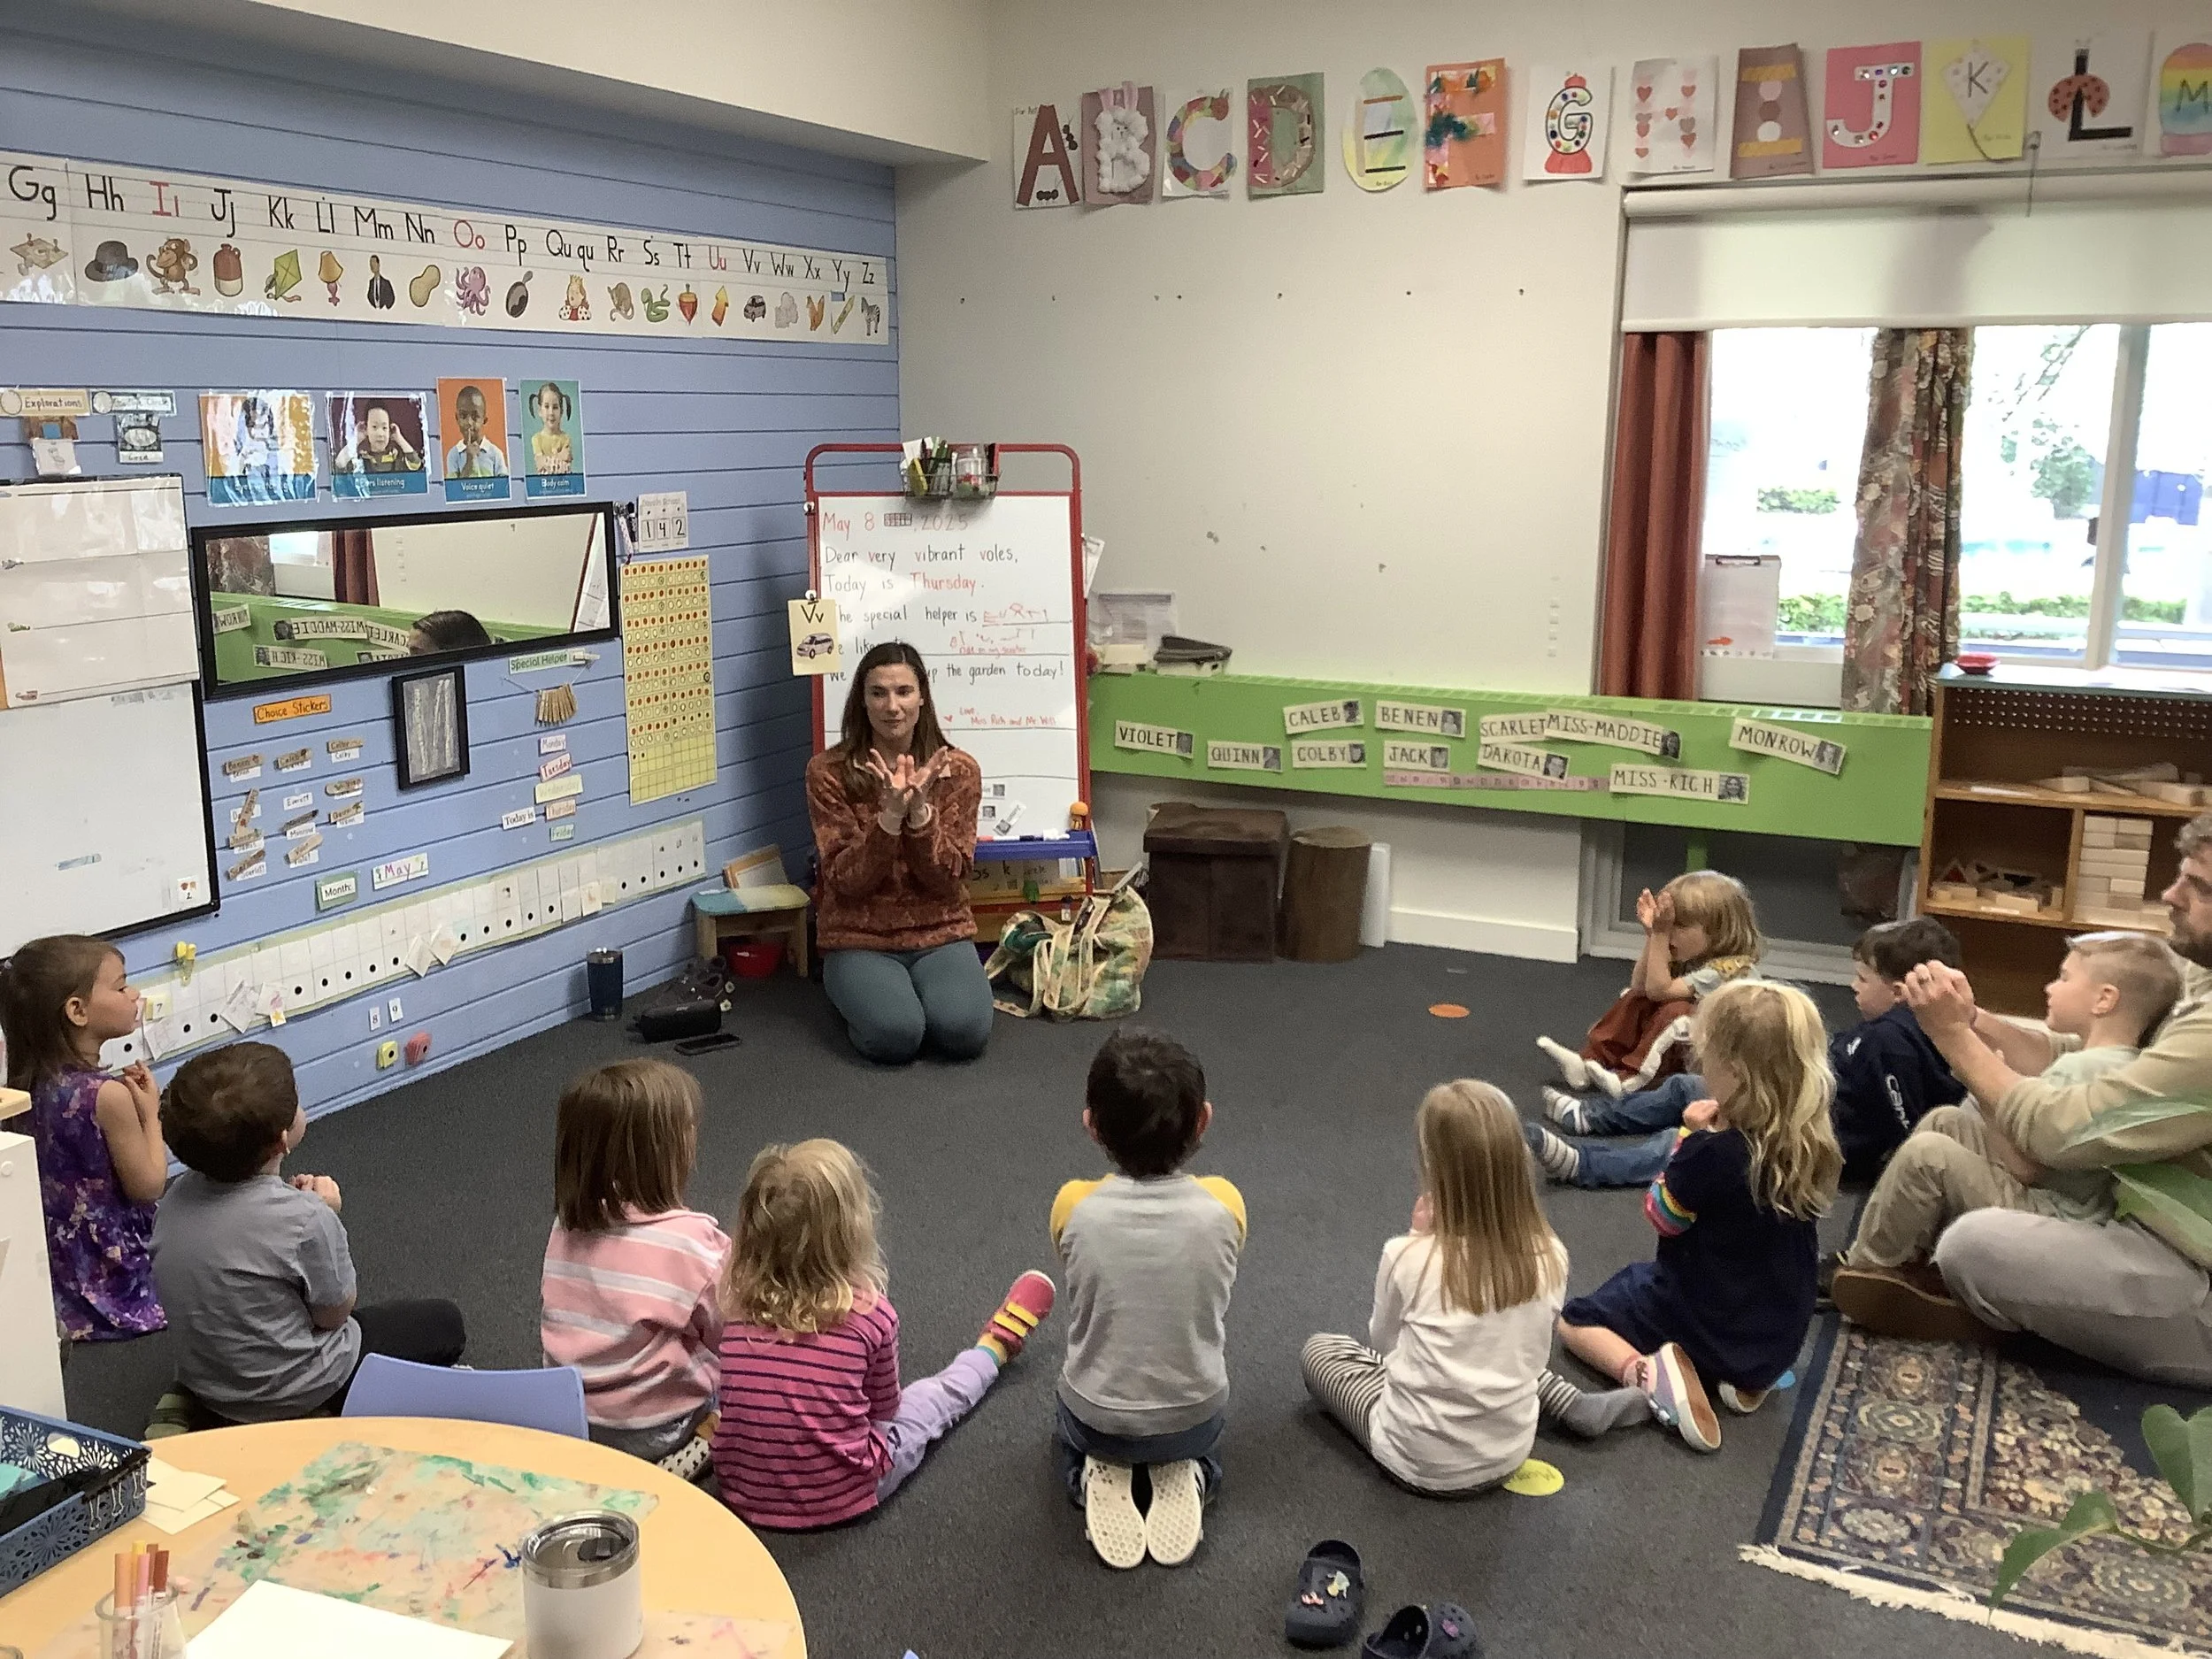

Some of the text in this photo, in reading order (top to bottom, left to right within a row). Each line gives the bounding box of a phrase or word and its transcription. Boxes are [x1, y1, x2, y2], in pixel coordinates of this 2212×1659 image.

[1968, 60, 1989, 98] K
[2068, 48, 2134, 142] L
[2176, 78, 2209, 113] M
[1826, 62, 1915, 149] J
[1545, 86, 1594, 155] G
[1017, 104, 1079, 206] A
[9, 165, 57, 221] Gg
[86, 174, 125, 211] Hh
[211, 188, 235, 237] Jj
[268, 195, 295, 229] Kk
[316, 198, 335, 234] Ll
[354, 206, 393, 240] Mm
[405, 212, 435, 243] Nn
[454, 219, 485, 250] Oo
[505, 224, 527, 265] Pp
[608, 236, 625, 262] Rr
[644, 239, 660, 266] Ss
[673, 242, 691, 268] Tt
[709, 246, 727, 272] Uu
[742, 249, 762, 273] Vv
[771, 253, 794, 278] Ww
[804, 256, 821, 280] Xx
[833, 259, 849, 292] Yy
[862, 262, 874, 285] Zz
[25, 396, 82, 409] Explorations
[377, 478, 404, 488] listening
[461, 482, 477, 491] Voice
[541, 479, 556, 488] Body
[822, 512, 850, 541] May
[864, 512, 874, 531] 8
[825, 543, 1018, 571] Dear very vibrant voles,
[826, 574, 867, 600] Today
[882, 577, 894, 590] is
[802, 604, 825, 624] Vv
[839, 605, 977, 630] he special helper is
[511, 654, 567, 672] Special Helper
[947, 663, 962, 677] the
[969, 664, 1006, 682] garden
[1018, 661, 1064, 680] today!
[257, 700, 328, 720] Choice Stickers
[1288, 707, 1340, 726] CALEB
[1381, 707, 1438, 727] BENEN
[1119, 727, 1176, 749] VIOLET
[1738, 725, 1816, 758] MONROW
[1211, 746, 1260, 764] QUINN
[1297, 745, 1347, 763] COLBY
[1389, 746, 1428, 764] JACK
[1483, 744, 1540, 771] DAKOTA
[543, 758, 572, 777] Tuesday
[504, 810, 534, 826] Today is
[385, 863, 411, 881] May
[325, 885, 352, 898] Month:
